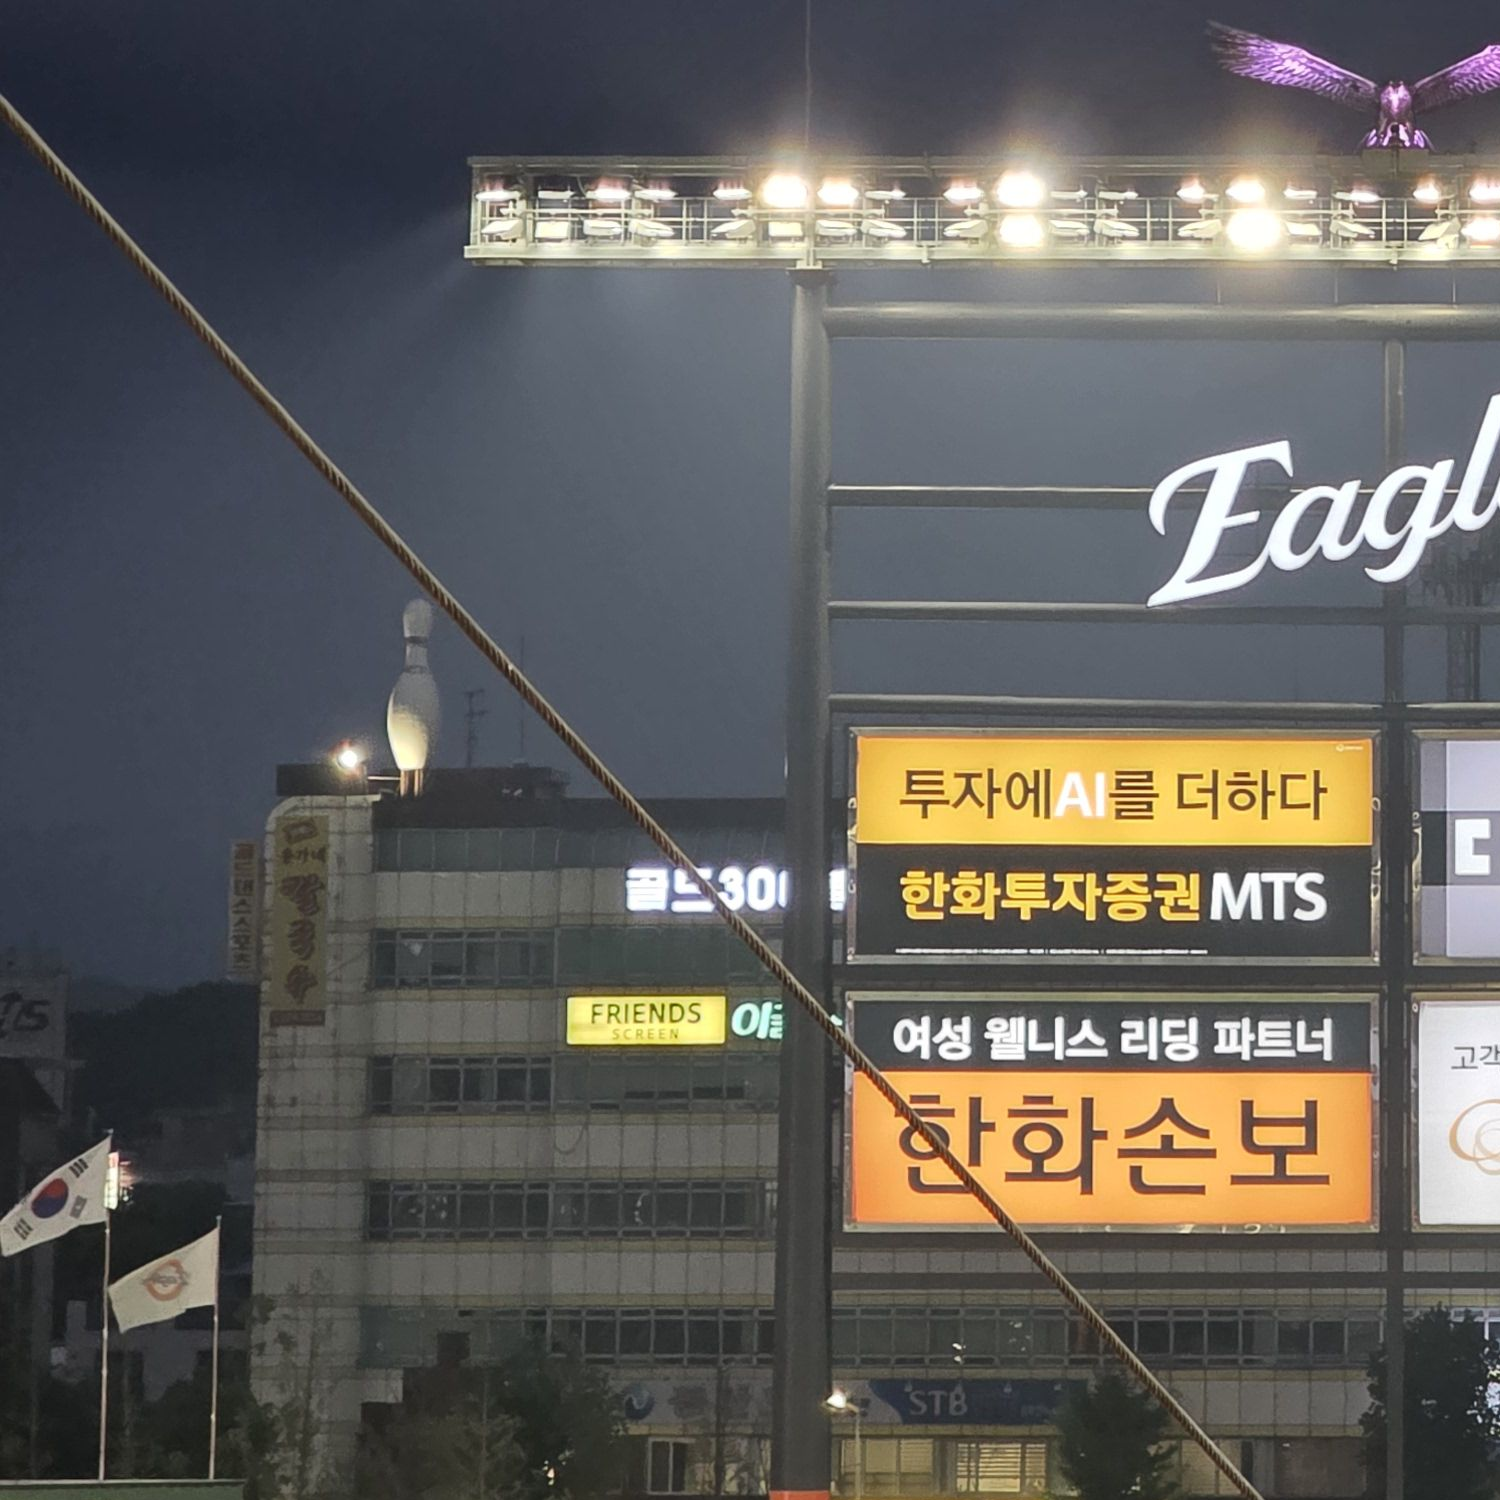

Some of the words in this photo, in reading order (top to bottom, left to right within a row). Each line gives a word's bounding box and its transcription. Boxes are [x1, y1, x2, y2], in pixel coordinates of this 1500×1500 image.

[899, 767, 1160, 820] 투자에AI를
[1176, 768, 1328, 820] 더하다
[900, 869, 1201, 921] 한화투자증권
[1210, 871, 1328, 922] MTS
[591, 1002, 702, 1025] FRIENDS
[612, 1028, 679, 1040] SCREEN
[893, 1015, 972, 1061] 여성
[984, 1016, 1108, 1061] 웰니스
[1120, 1017, 1199, 1061] 리딩
[1213, 1017, 1333, 1062] 파트너
[894, 1094, 1330, 1195] 한화손보
[909, 1389, 968, 1416] STB
